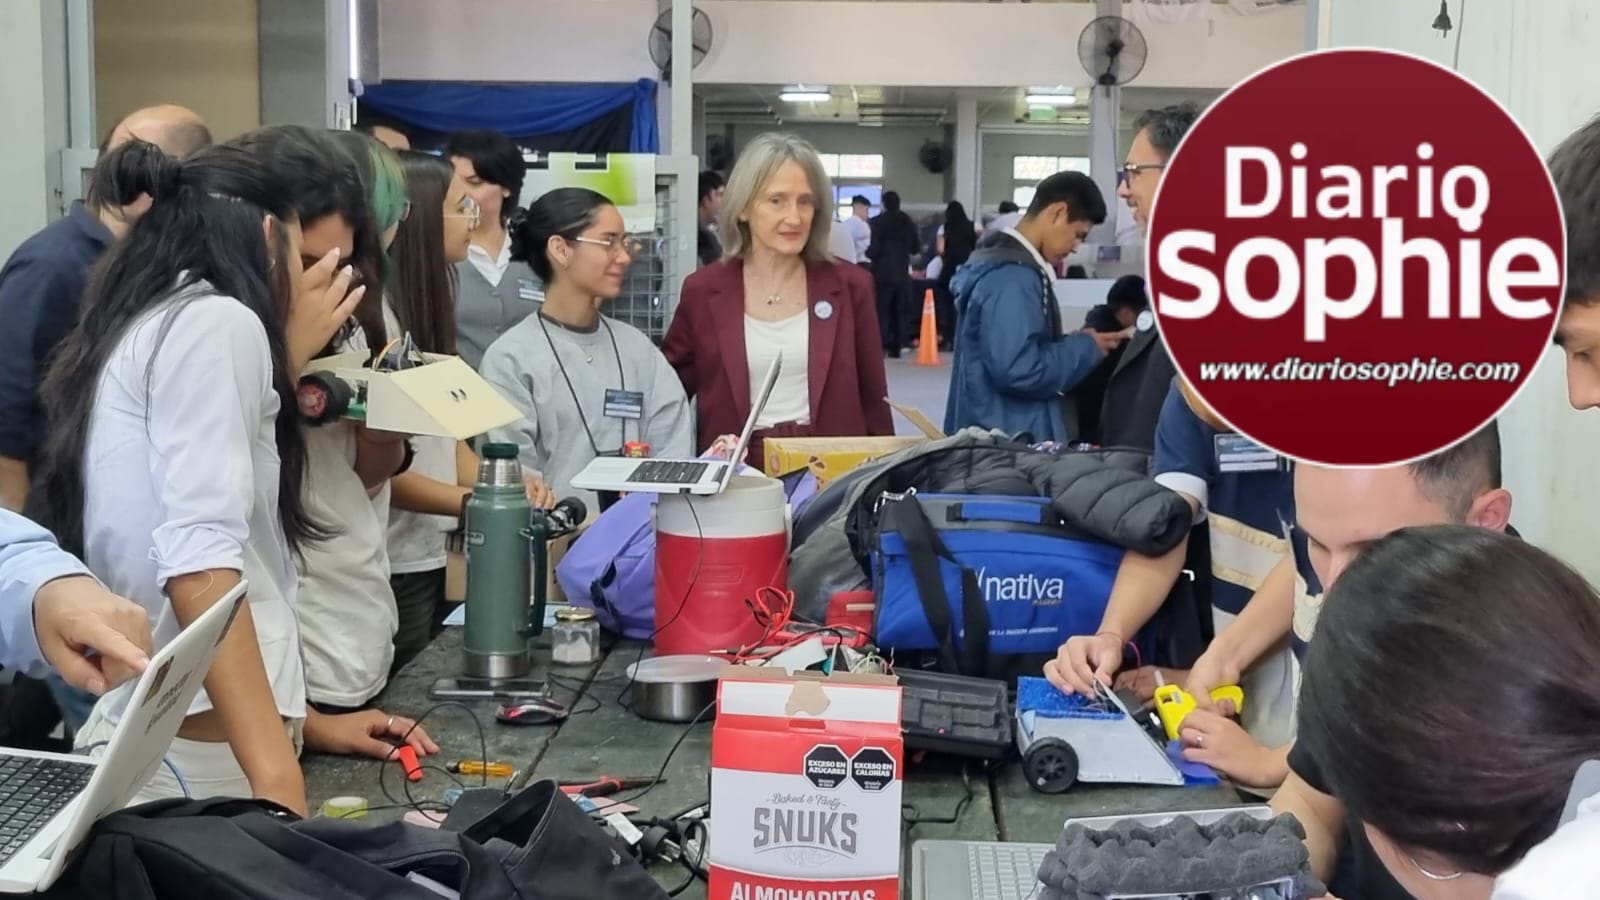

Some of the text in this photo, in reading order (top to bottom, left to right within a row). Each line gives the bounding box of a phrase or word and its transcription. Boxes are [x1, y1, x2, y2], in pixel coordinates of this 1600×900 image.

[985, 573, 1064, 601] nativa
[808, 760, 846, 769] EXCESO EN
[854, 762, 893, 771] EXCESO EN
[771, 792, 805, 804] Baked
[753, 807, 857, 854] SNUKS
